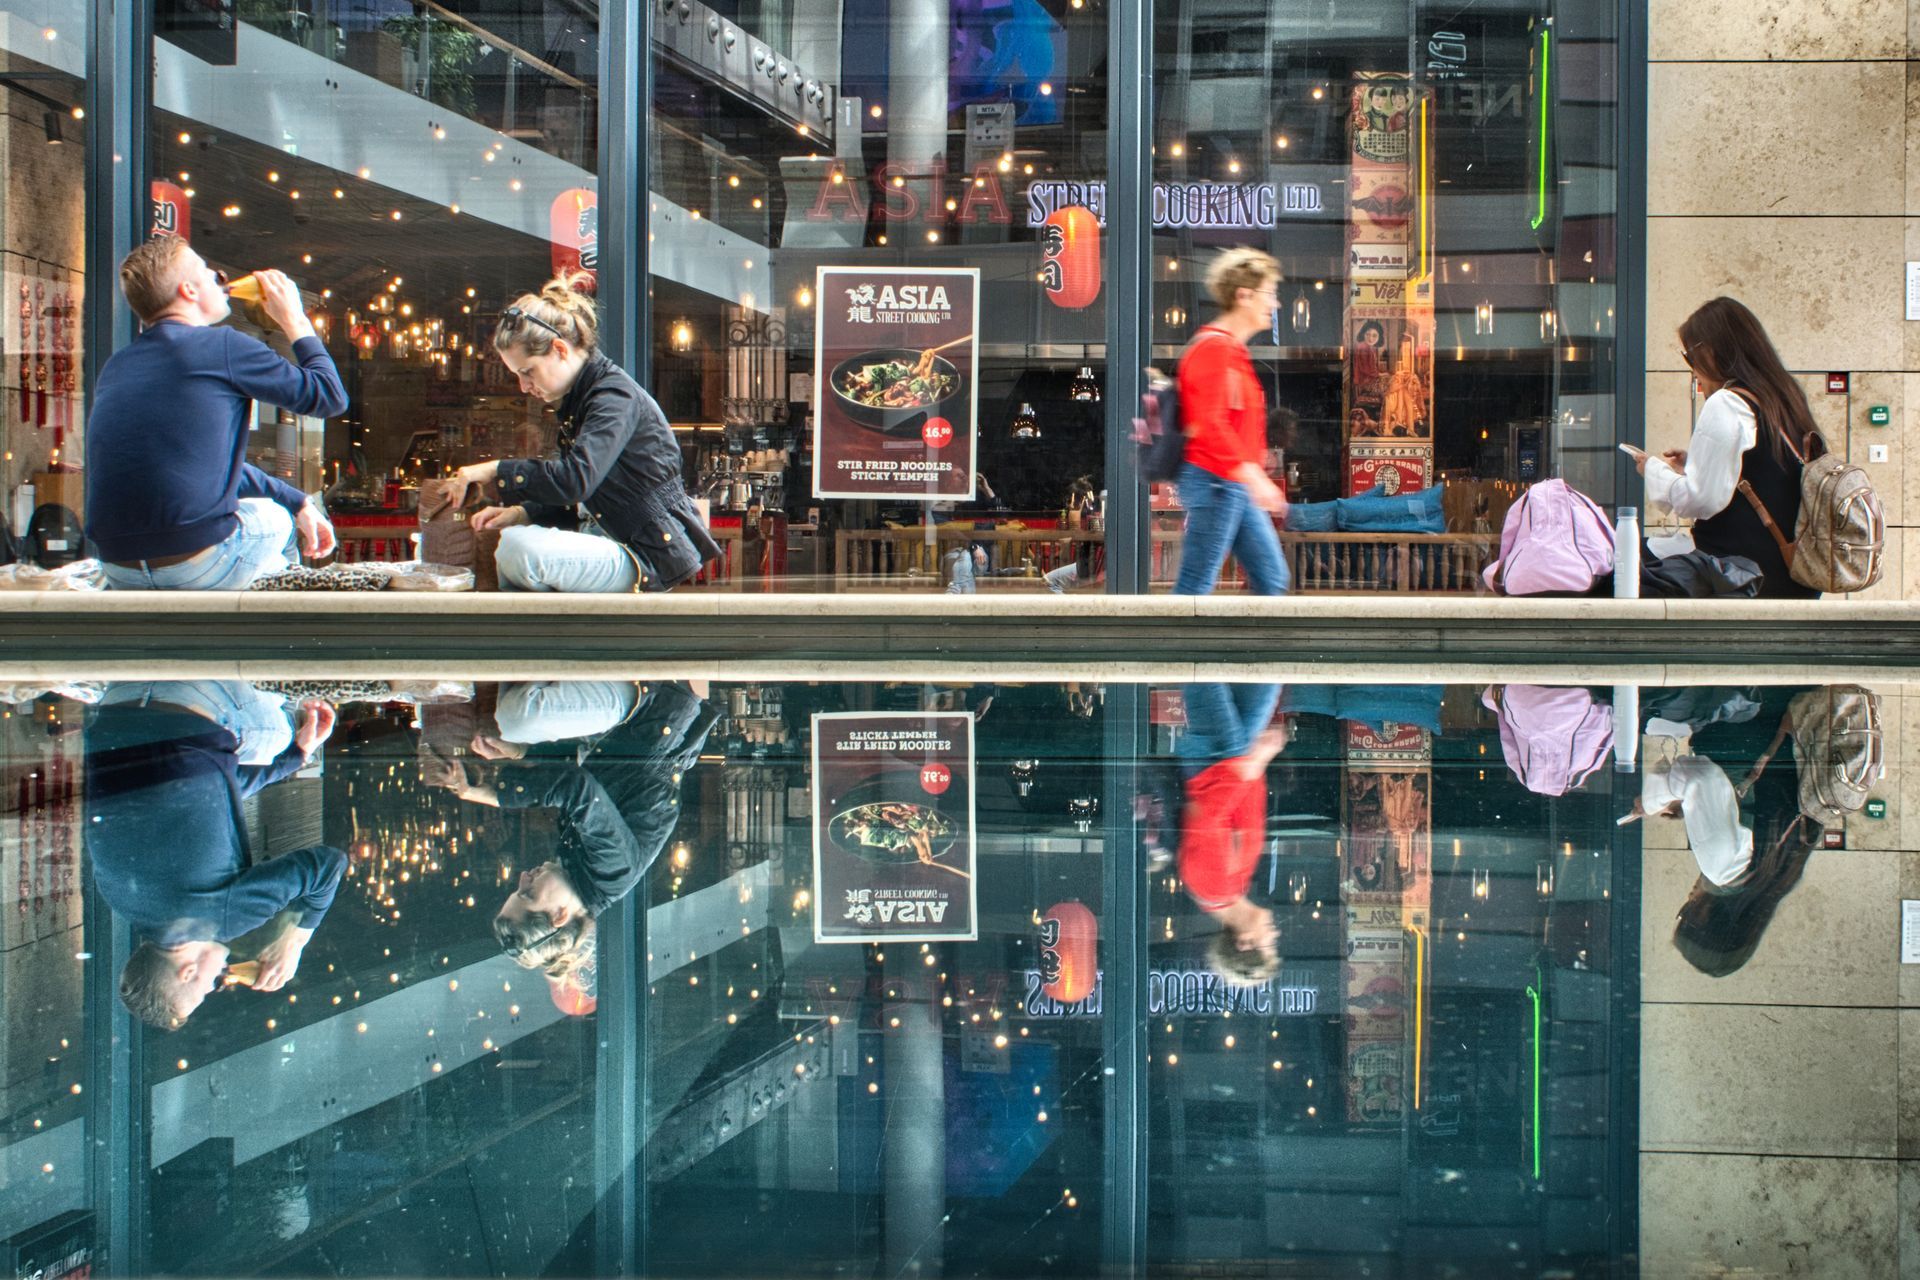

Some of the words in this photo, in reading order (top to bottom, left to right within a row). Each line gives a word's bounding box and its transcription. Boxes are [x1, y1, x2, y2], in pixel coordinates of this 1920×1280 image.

[806, 158, 1012, 223] ASIA
[1152, 183, 1275, 225] COOKING
[1285, 184, 1322, 210] LTD.
[876, 285, 951, 310] ASIA
[847, 306, 873, 323] 龍
[876, 311, 905, 323] STREET
[906, 312, 940, 324] COOKING
[837, 460, 863, 470] STIR
[866, 461, 898, 470] FRIED
[900, 461, 952, 471] NOODLES
[850, 471, 891, 481] STICKY
[893, 472, 939, 481] TEMPEH
